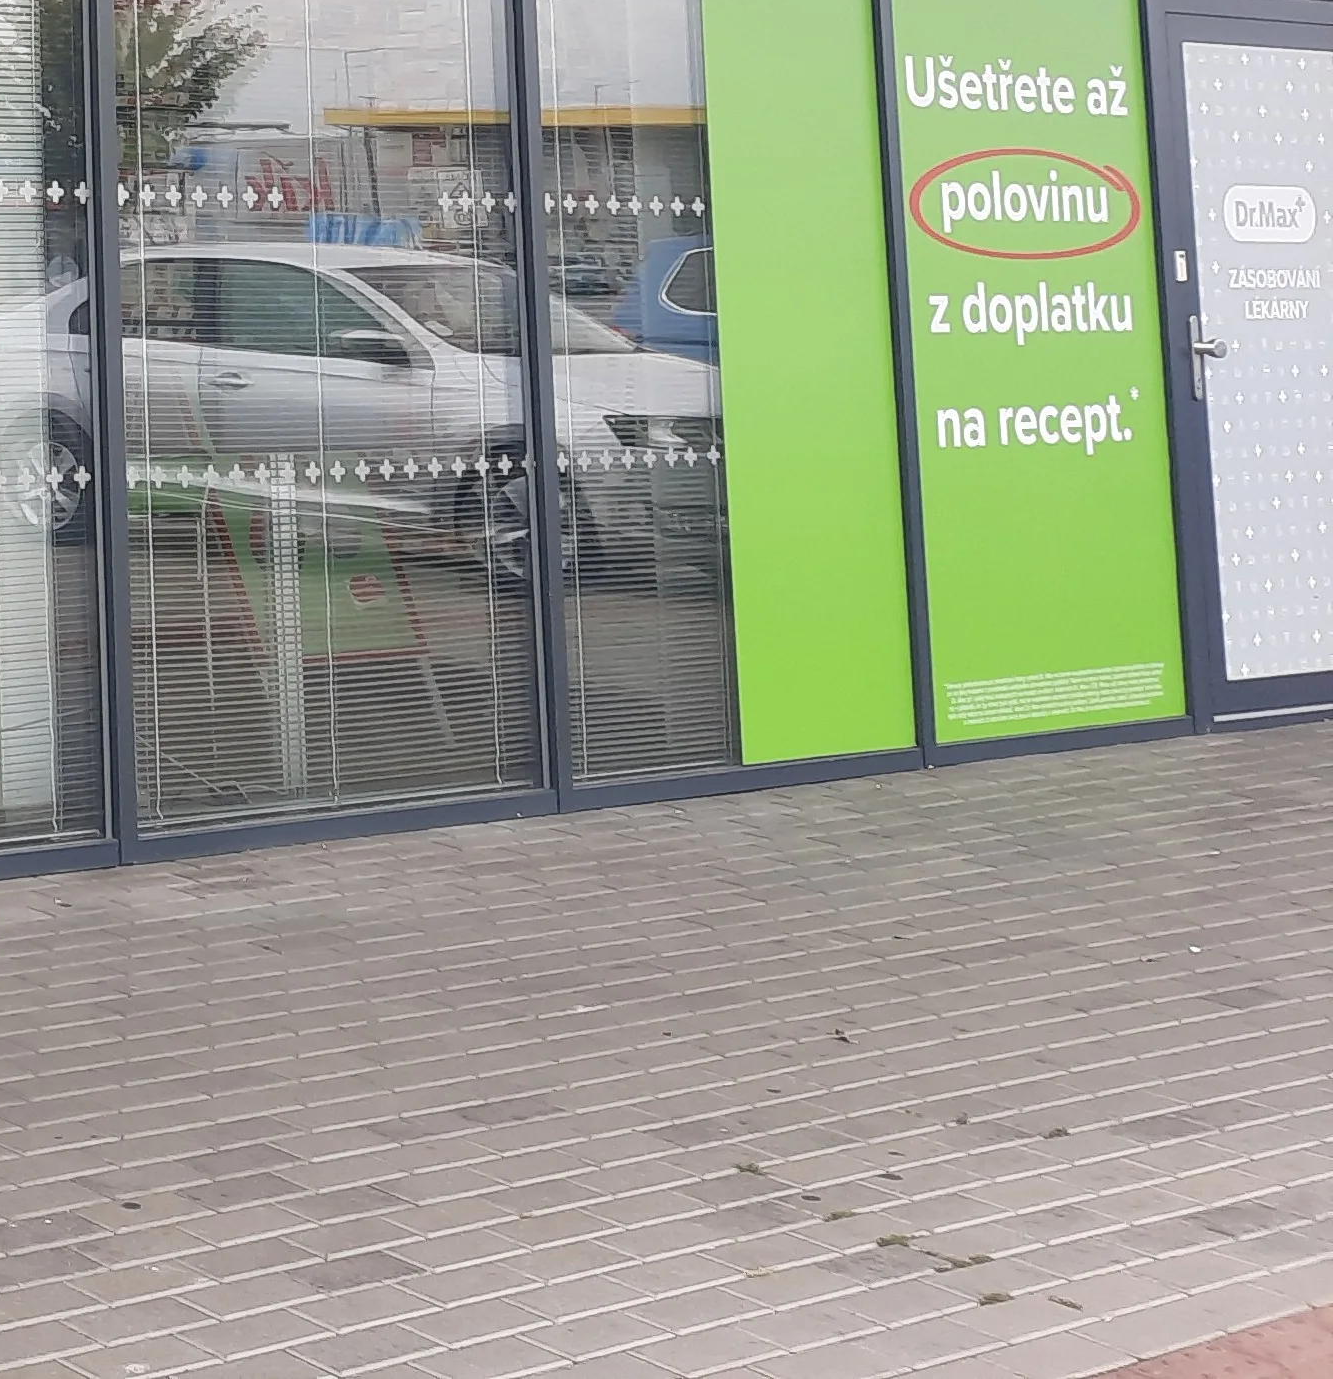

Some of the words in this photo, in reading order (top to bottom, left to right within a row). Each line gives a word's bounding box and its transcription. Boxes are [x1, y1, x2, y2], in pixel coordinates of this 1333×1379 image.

[904, 55, 1075, 114] Ušetřete
[1086, 65, 1129, 116] až
[940, 169, 1109, 233] polovinu
[1234, 200, 1300, 229] Dr.Max
[1228, 264, 1320, 289] ZÁSOBOVÁNÍ
[928, 293, 951, 334] z
[962, 281, 1134, 345] doplatku
[1245, 295, 1310, 319] LÉKÁRNY
[935, 405, 986, 448] na
